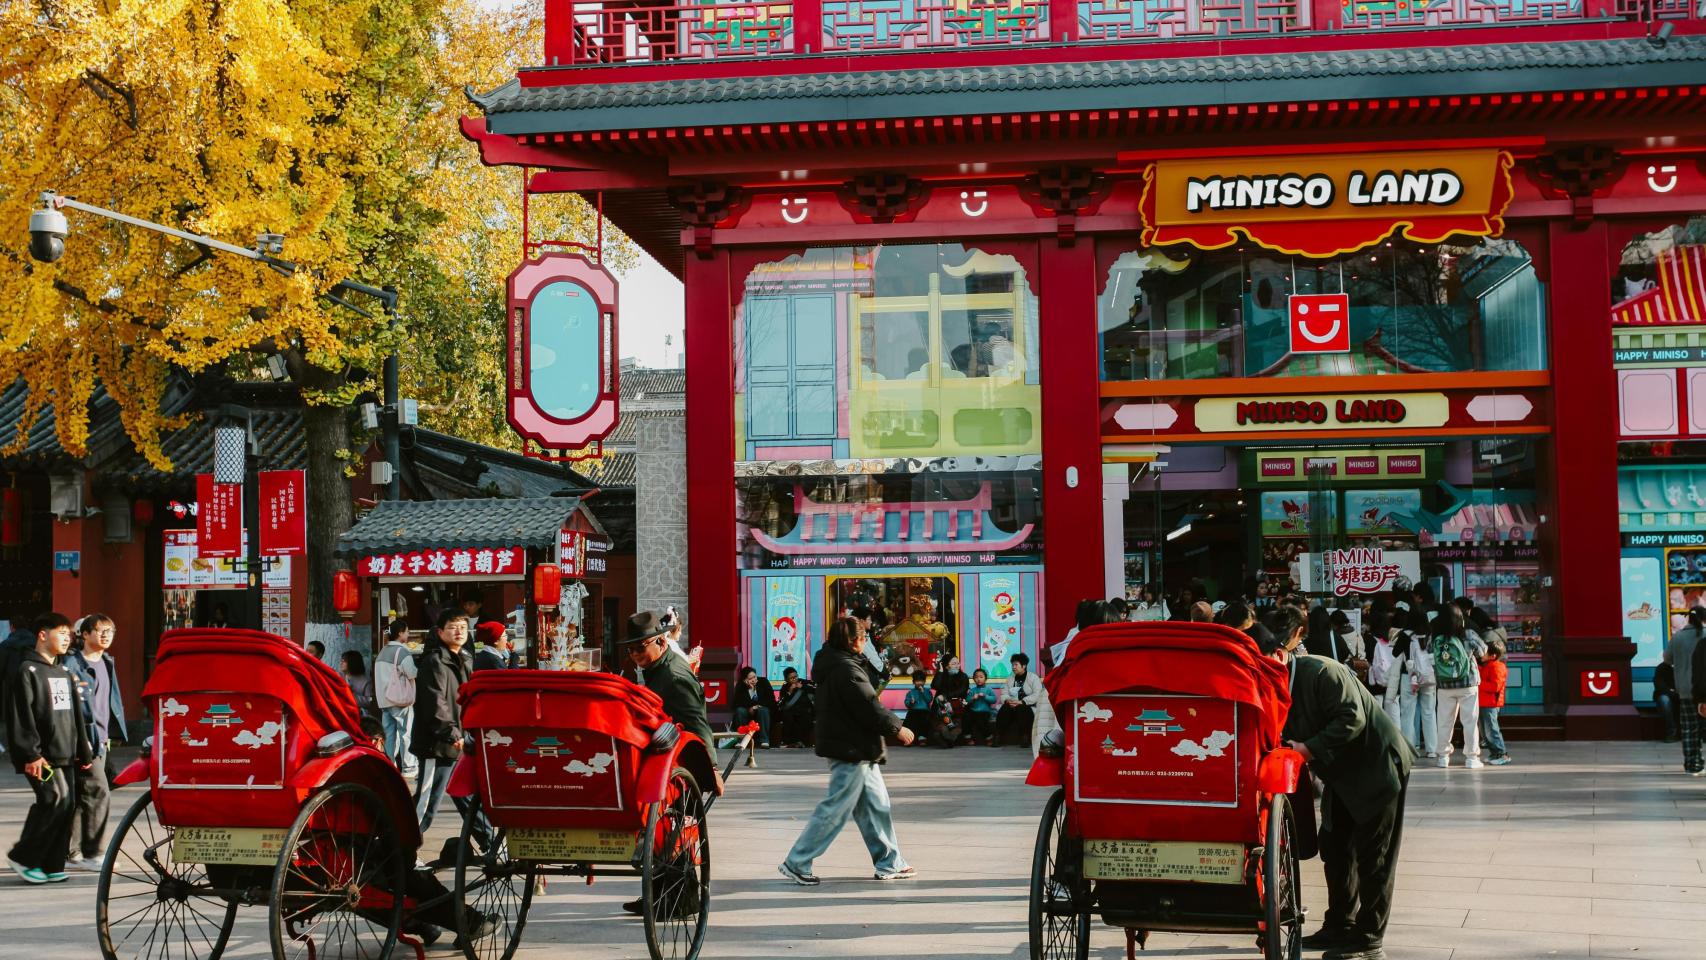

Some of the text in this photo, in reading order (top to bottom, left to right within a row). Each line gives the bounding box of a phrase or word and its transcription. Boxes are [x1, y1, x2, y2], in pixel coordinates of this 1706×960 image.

[1186, 171, 1463, 211] MINISO LAND
[1616, 350, 1688, 361] HAPPY MINISO
[1236, 399, 1406, 426] MINISO LAND
[1631, 535, 1704, 544] HAPPY MINISO
[368, 550, 515, 575] 奶皮子冰糖葫芦
[793, 557, 846, 566] HAPPY MINISO
[855, 556, 908, 565] HAPPY MINISO
[917, 555, 971, 564] HAPPY MINISO
[980, 554, 995, 562] HAP
